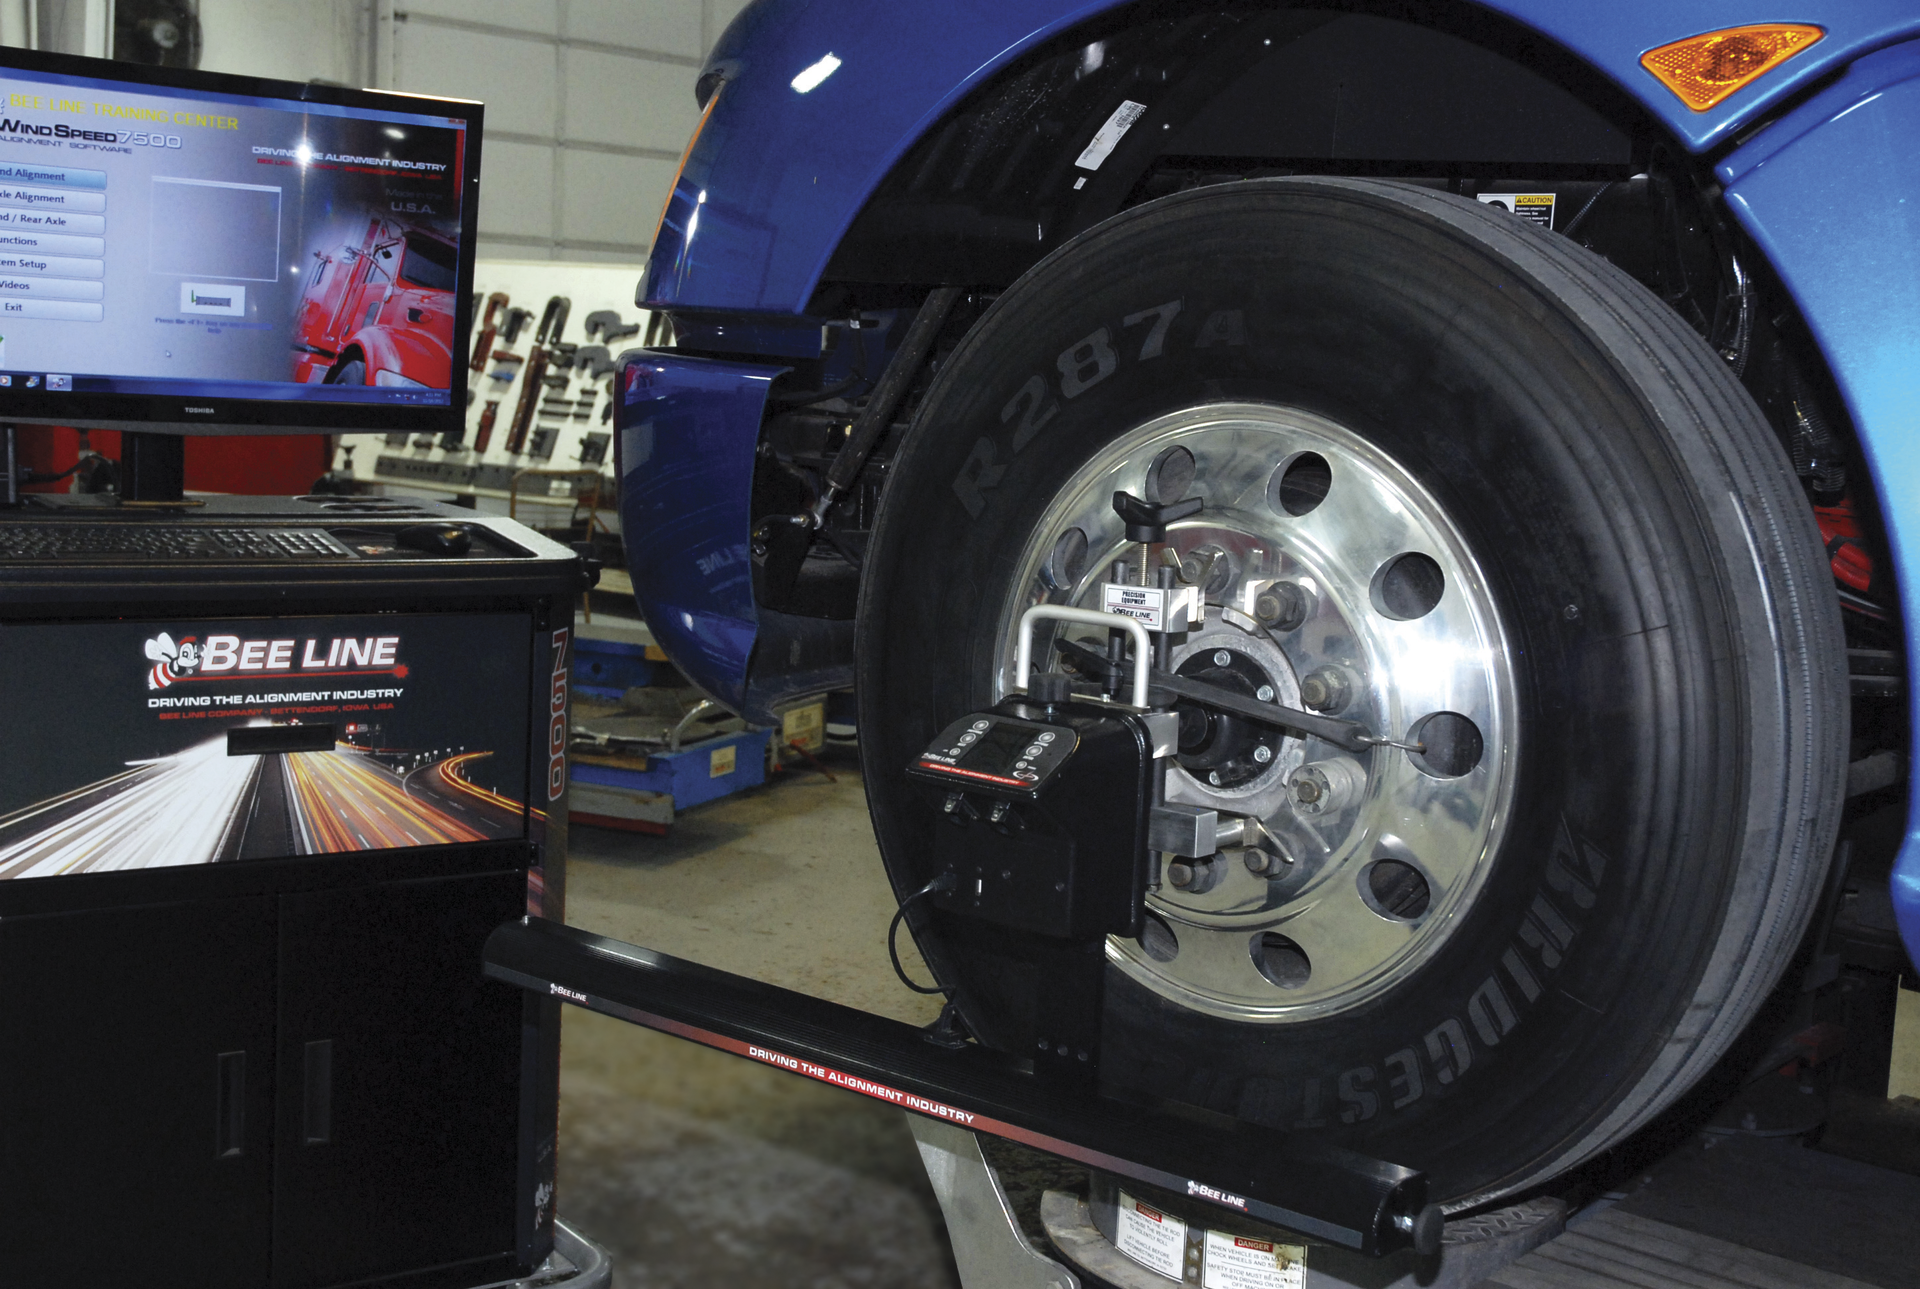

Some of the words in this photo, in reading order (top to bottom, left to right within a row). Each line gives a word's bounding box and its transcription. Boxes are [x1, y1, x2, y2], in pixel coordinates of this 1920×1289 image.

[10, 93, 44, 110] BEE
[50, 98, 87, 115] LINE
[92, 102, 169, 123] TRAINING
[173, 111, 239, 131] CENTER
[69, 141, 133, 154] SOFTWARE
[325, 153, 391, 167] ALIGNMENT
[392, 160, 447, 172] INDUSTRY
[15, 168, 66, 182] Alignment
[15, 191, 65, 203] Alignment
[390, 201, 436, 214] U.S.A.
[20, 214, 42, 224] Rear
[45, 216, 67, 226] Axle
[19, 259, 47, 271] Setup
[5, 302, 23, 312] Exit
[184, 406, 215, 414] TOSHIBA
[1121, 597, 1147, 605] EQUIPMENT
[1122, 590, 1146, 599] PRECISION
[200, 635, 295, 672] BEE
[302, 637, 400, 668] LINE
[148, 696, 211, 708] DRIVING
[213, 694, 243, 705] THE
[245, 691, 331, 704] ALIGNMENT
[333, 688, 404, 700] INDUSTRY
[159, 712, 181, 720] BEE
[182, 711, 206, 719] LINE
[208, 708, 263, 718] COMPANY
[343, 703, 370, 711] IOWA
[548, 627, 568, 801] 7500
[929, 763, 951, 772] DRIVING
[961, 769, 993, 780] ALIGNMENT
[992, 776, 1020, 785] INDUSTRY
[558, 986, 572, 997] BEE
[572, 991, 588, 1002] LINE
[749, 1046, 798, 1069] DRIVING
[801, 1062, 826, 1078] THE
[828, 1072, 903, 1102] ALIGNMENT
[906, 1095, 975, 1124] INDUSTRY
[1199, 1185, 1221, 1200] BEE
[1221, 1193, 1246, 1208] LINE
[1138, 1204, 1160, 1220] DANGER
[1133, 1218, 1146, 1227] CAUSE
[1147, 1225, 1155, 1233] THE
[1156, 1230, 1175, 1242] VEHICLE
[1135, 1226, 1156, 1240] VIOLENTLY
[1157, 1236, 1168, 1246] ROLL
[1152, 1221, 1161, 1230] THE
[1170, 1229, 1181, 1237] ROD
[1123, 1238, 1155, 1260] DISCONNECTING
[1162, 1260, 1174, 1268] ROD
[1135, 1239, 1151, 1251] VEHICLE
[1152, 1247, 1170, 1260] BEFORE
[1209, 1244, 1227, 1252] WHEN
[1228, 1248, 1253, 1258] VEHICLE
[1237, 1239, 1270, 1251] DANGER
[1207, 1249, 1226, 1259] CHOCK
[1228, 1254, 1253, 1264] WHEELS
[1206, 1261, 1228, 1272] SAFETY
[1229, 1267, 1245, 1276] STOP
[1246, 1271, 1262, 1279] MUST
[1281, 1277, 1301, 1286] PACE
[1221, 1272, 1238, 1281] WHEN
[1239, 1276, 1264, 1286] DRIVING
